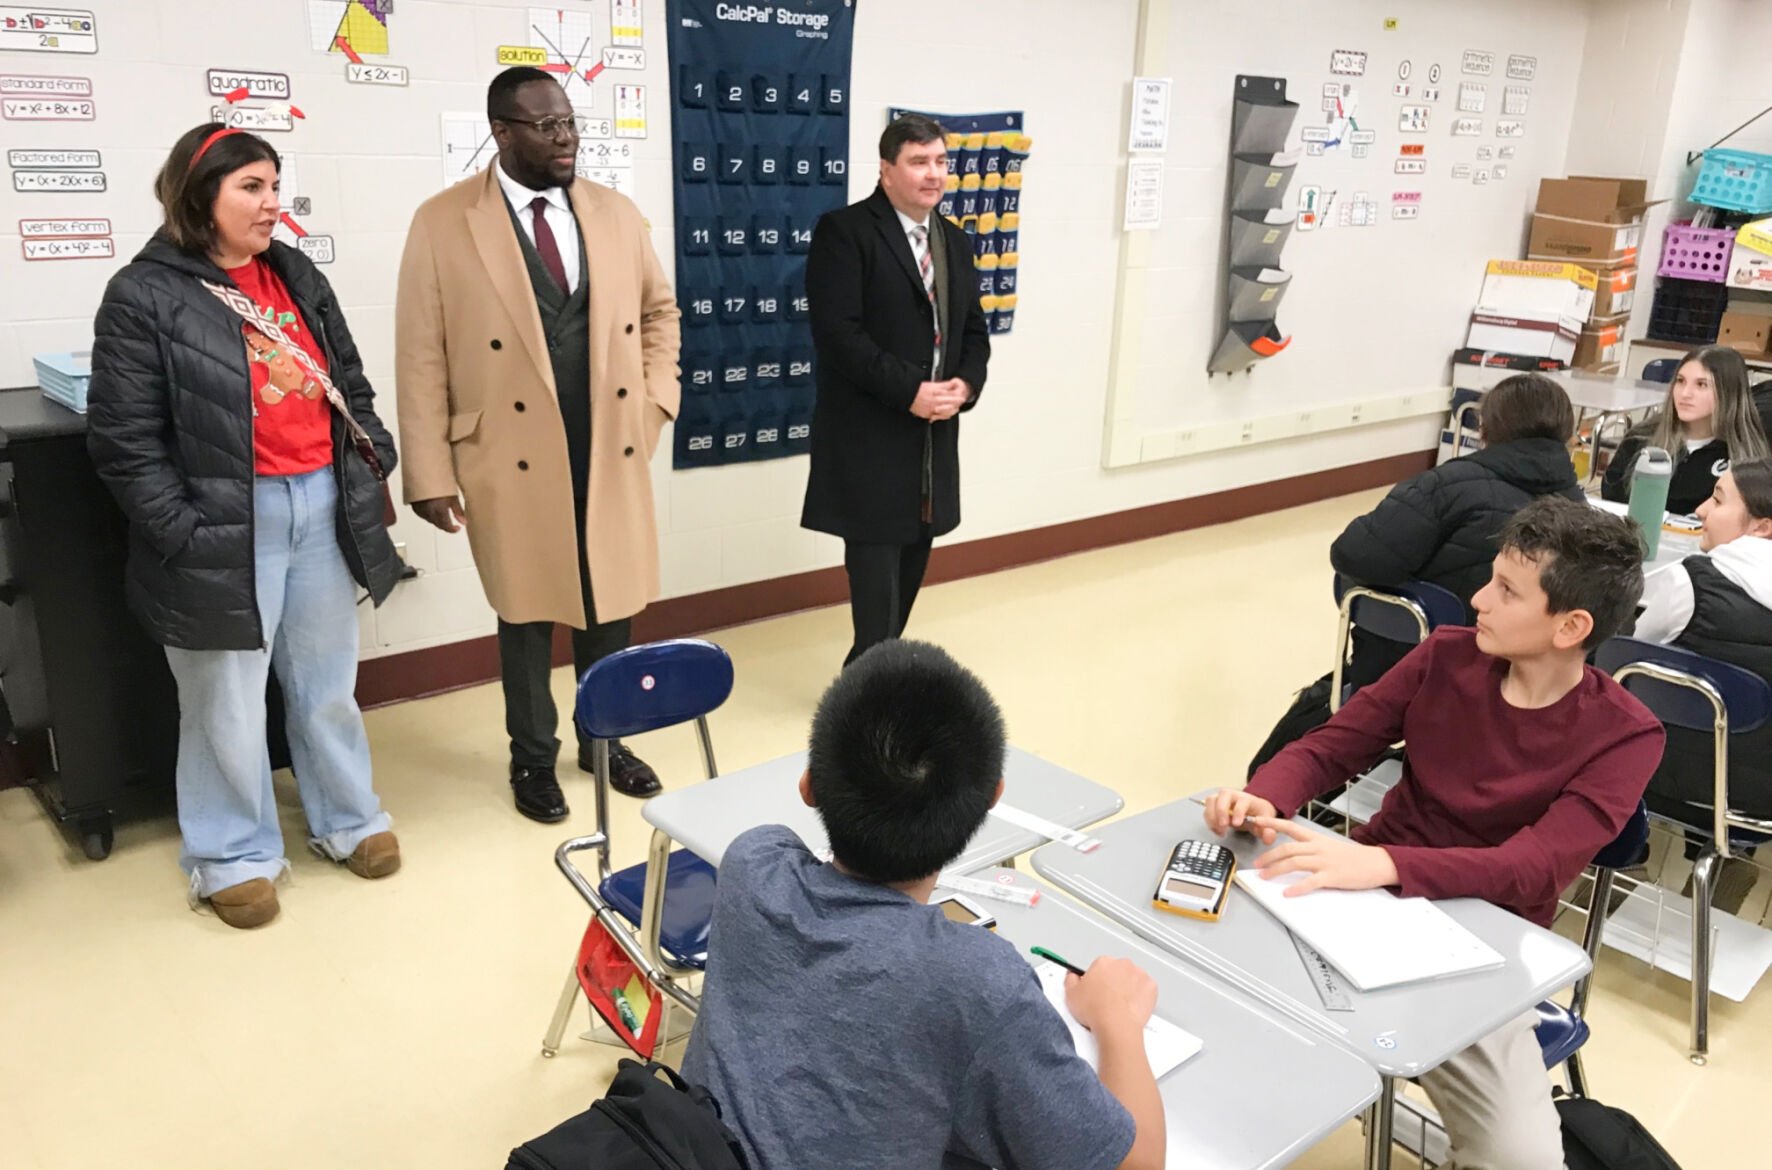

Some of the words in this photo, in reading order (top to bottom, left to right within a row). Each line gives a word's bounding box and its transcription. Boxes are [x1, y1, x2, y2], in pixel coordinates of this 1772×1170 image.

[777, 8, 829, 29] Storage
[796, 29, 828, 39] Graphing
[500, 50, 545, 63] solution
[375, 68, 390, 80] 2x
[1, 79, 55, 90] standard
[57, 80, 89, 91] form
[211, 76, 286, 93] quadratic
[694, 83, 703, 97] 1
[729, 86, 742, 101] 2
[765, 88, 777, 102] 3
[797, 89, 810, 103] 4
[829, 89, 842, 103] 5
[54, 103, 70, 115] 8x
[80, 104, 91, 115] 12
[600, 121, 609, 135] 6
[597, 143, 611, 157] 2x
[621, 144, 630, 157] 6
[13, 152, 65, 163] factored
[67, 153, 98, 163] form
[965, 158, 978, 172] 04
[986, 157, 1000, 172] 05
[692, 157, 706, 171] 6
[730, 159, 743, 173] 7
[762, 159, 775, 173] 8
[797, 160, 810, 175] 9
[824, 160, 845, 174] 10
[963, 198, 975, 213] 10
[984, 197, 995, 213] 11
[1004, 196, 1016, 211] 12
[24, 222, 70, 233] vertex
[72, 221, 107, 232] form
[302, 239, 328, 248] zero
[693, 230, 708, 244] 11
[723, 230, 745, 245] 12
[758, 230, 778, 244] 13
[792, 230, 812, 244] 14
[101, 242, 110, 252] 4
[692, 300, 712, 314] 16
[724, 298, 745, 312] 17
[757, 299, 777, 313] 18
[693, 370, 712, 385] 21
[725, 367, 747, 382] 22
[757, 364, 780, 377] 23
[789, 362, 811, 376] 24
[689, 435, 712, 450] 26
[725, 433, 746, 448] 27
[756, 429, 778, 443] 28
[788, 424, 810, 439] 29
